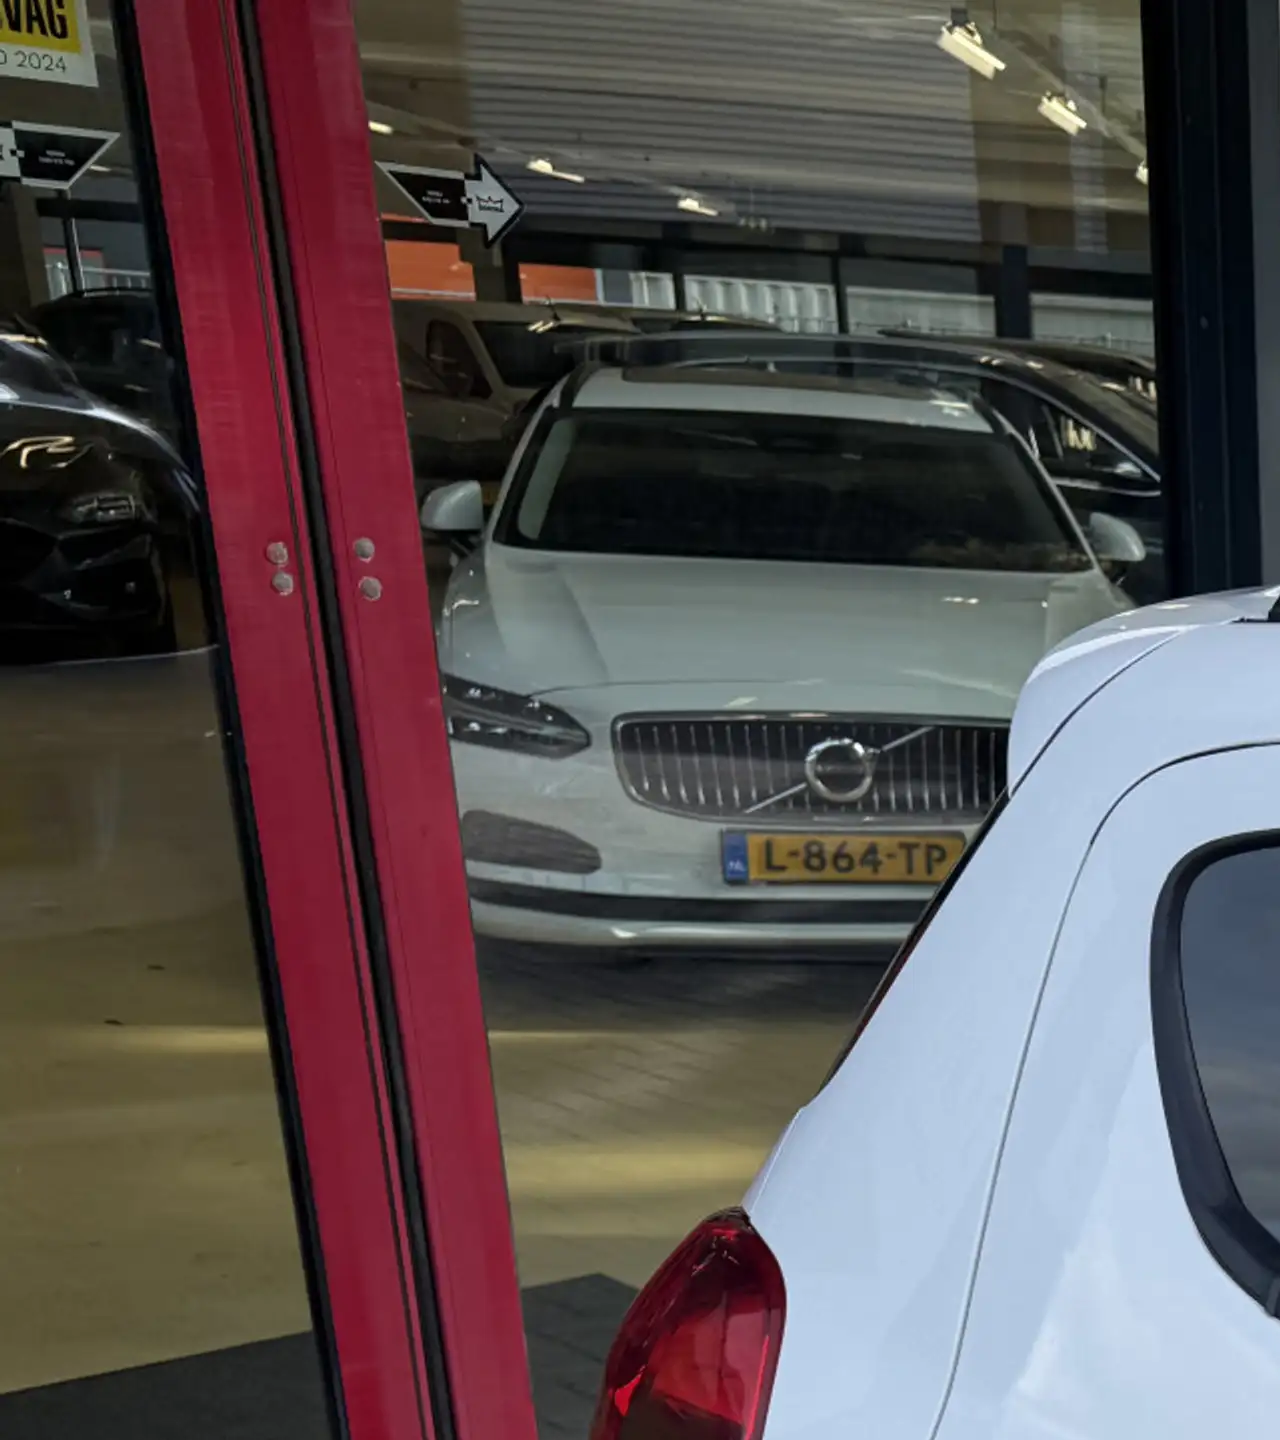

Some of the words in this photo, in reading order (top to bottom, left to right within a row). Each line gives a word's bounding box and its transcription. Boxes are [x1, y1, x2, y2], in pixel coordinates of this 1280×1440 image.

[0, 0, 68, 39] VAG
[15, 49, 66, 73] 2024
[764, 838, 948, 876] L-864-TP
